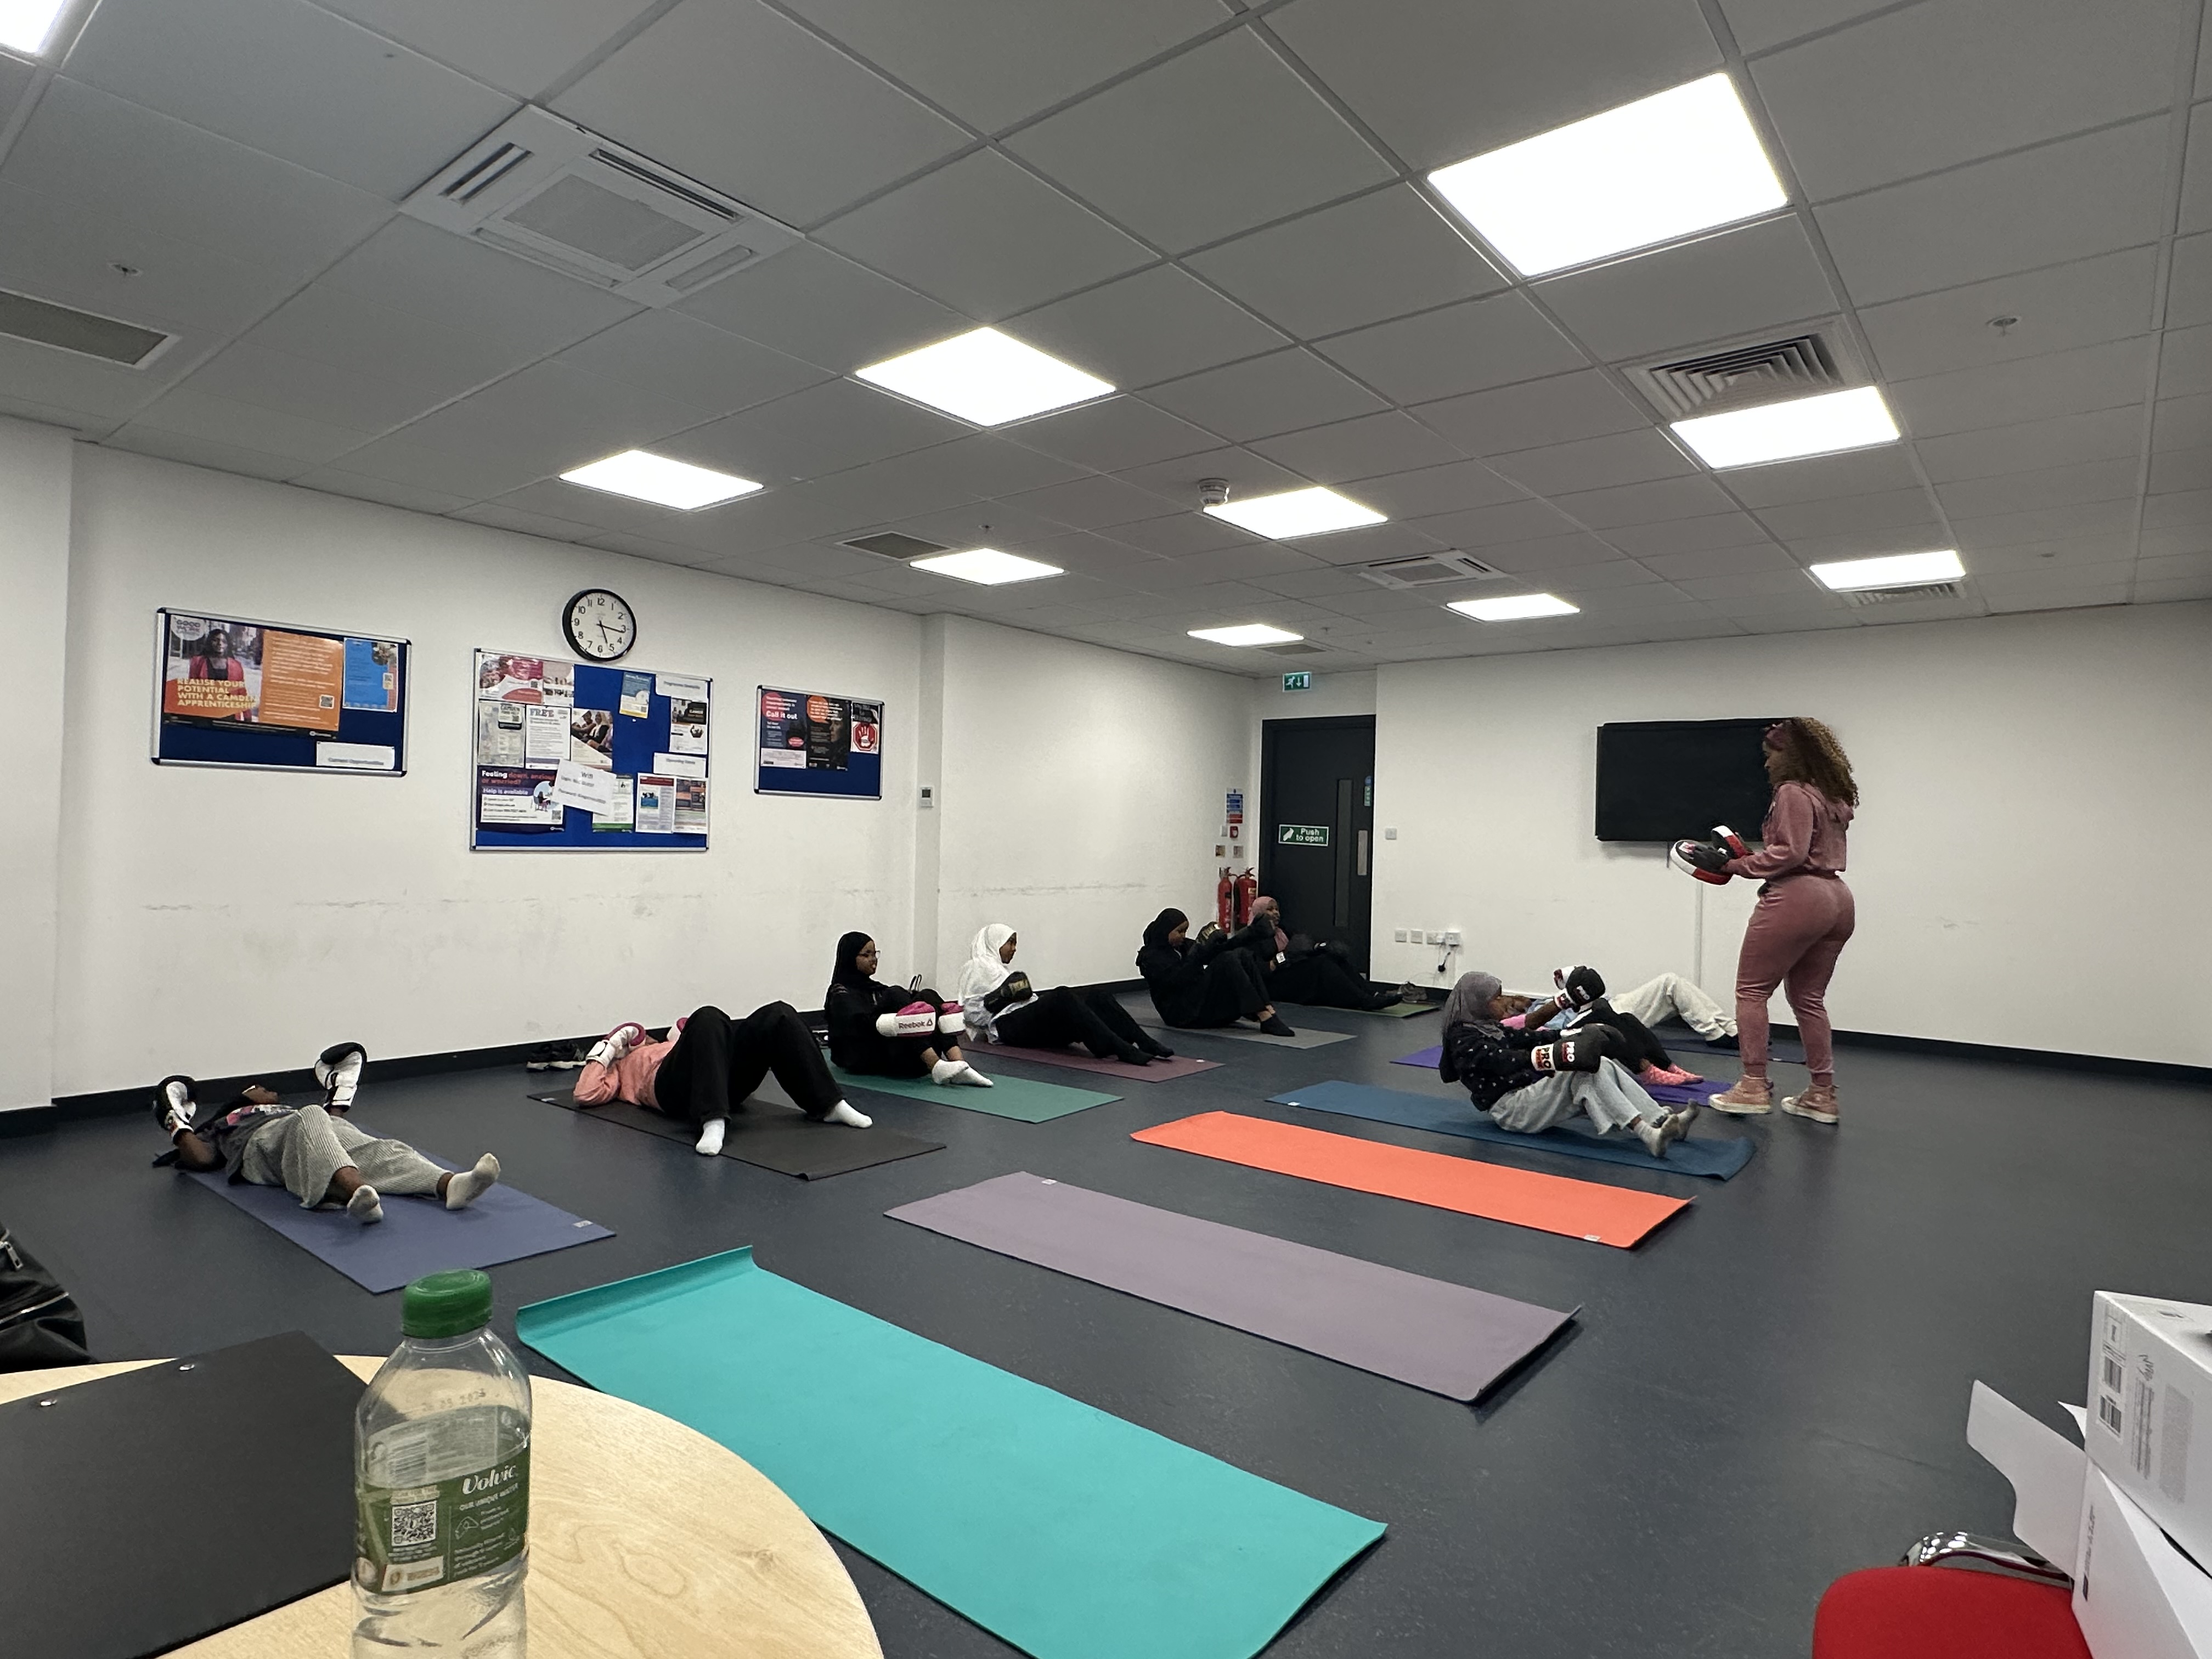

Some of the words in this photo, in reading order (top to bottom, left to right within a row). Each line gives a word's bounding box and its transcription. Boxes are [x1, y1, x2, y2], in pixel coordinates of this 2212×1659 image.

[587, 599, 592, 607] 11
[597, 597, 605, 606] 12
[578, 606, 585, 614] 10
[574, 618, 580, 626] 9
[597, 645, 603, 653] 6
[608, 643, 614, 651] 5
[177, 685, 229, 693] POTENTIAL
[217, 694, 258, 702] CAMDEN
[177, 699, 257, 708] APPRENTICESHIP
[530, 708, 554, 717] FREE
[482, 770, 508, 778] Feeling
[1300, 827, 1319, 836] Push
[898, 1021, 926, 1029] Reebok
[1542, 1047, 1551, 1069] PRO
[462, 1465, 517, 1494] Volvic
